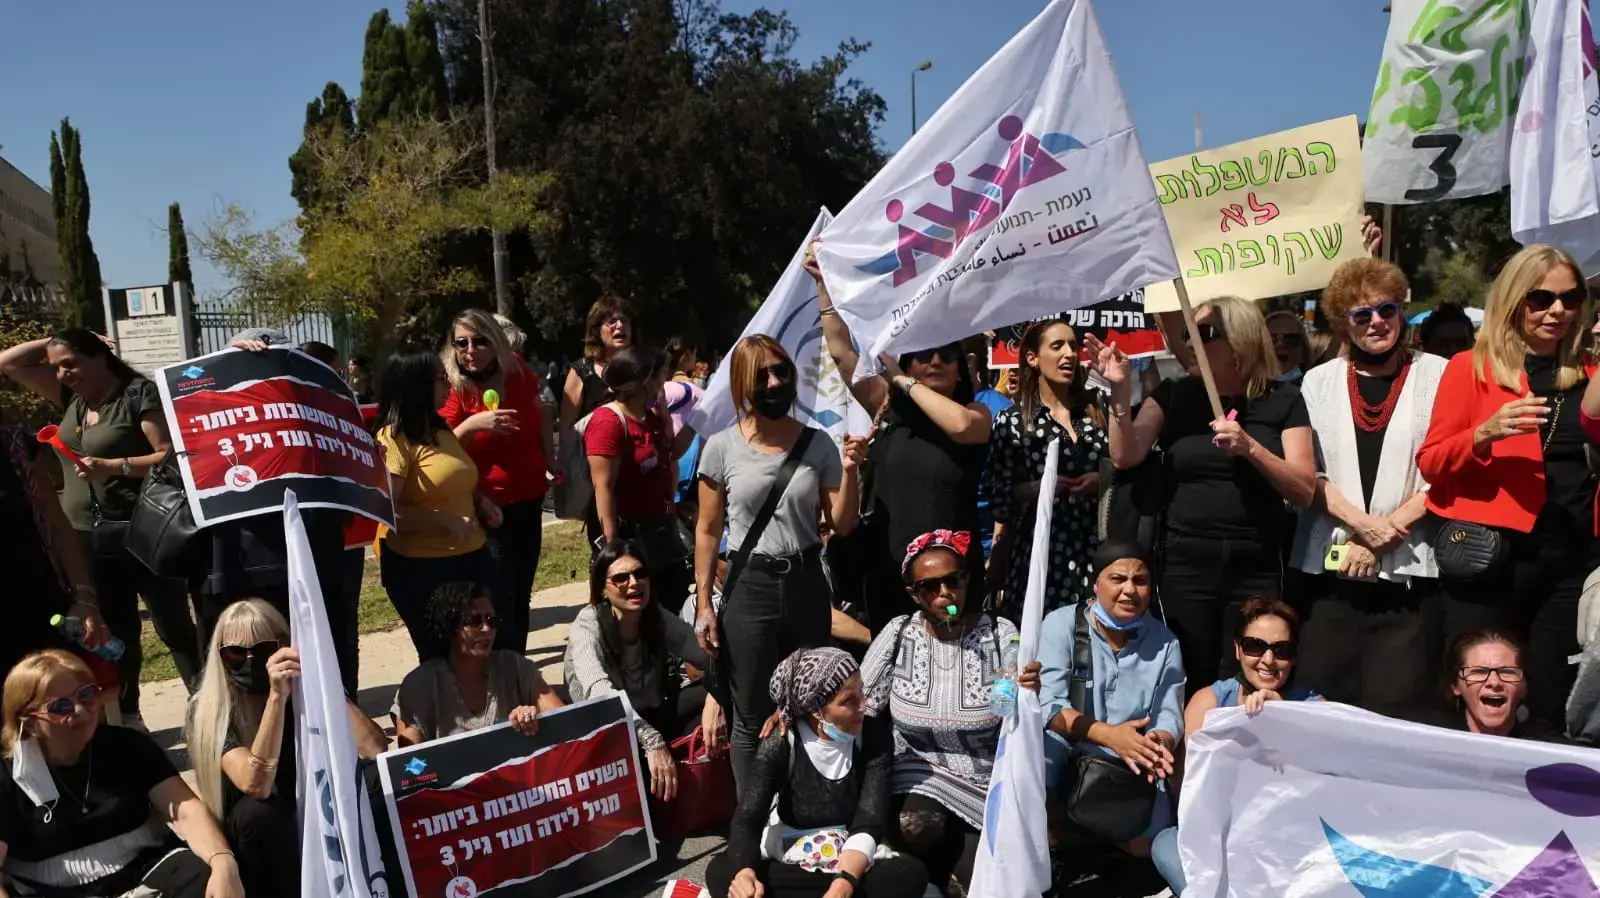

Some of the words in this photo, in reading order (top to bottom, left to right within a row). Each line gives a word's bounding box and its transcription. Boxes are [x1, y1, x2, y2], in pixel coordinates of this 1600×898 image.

[1156, 141, 1336, 204] המטפלות
[1404, 133, 1463, 201] 3
[1045, 187, 1092, 216] נעמת
[1220, 191, 1280, 233] לא
[1187, 222, 1342, 278] שקופות
[152, 291, 158, 311] 1
[1066, 309, 1095, 327] של
[1100, 310, 1145, 328] הרכה
[190, 404, 258, 433] ביותר:
[263, 402, 338, 429] החשובות
[217, 438, 233, 456] 3
[237, 432, 274, 453] גיל
[276, 430, 313, 447] ועד
[314, 433, 347, 457] לידה
[346, 442, 374, 468] מגיל
[575, 758, 629, 792] השנים
[482, 776, 572, 821] החשובות
[582, 793, 621, 822] מגיל
[411, 804, 479, 840] ביותר:
[536, 805, 580, 837] לידה
[458, 838, 492, 861] גיל
[497, 825, 533, 850] ועד
[439, 845, 456, 866] 3
